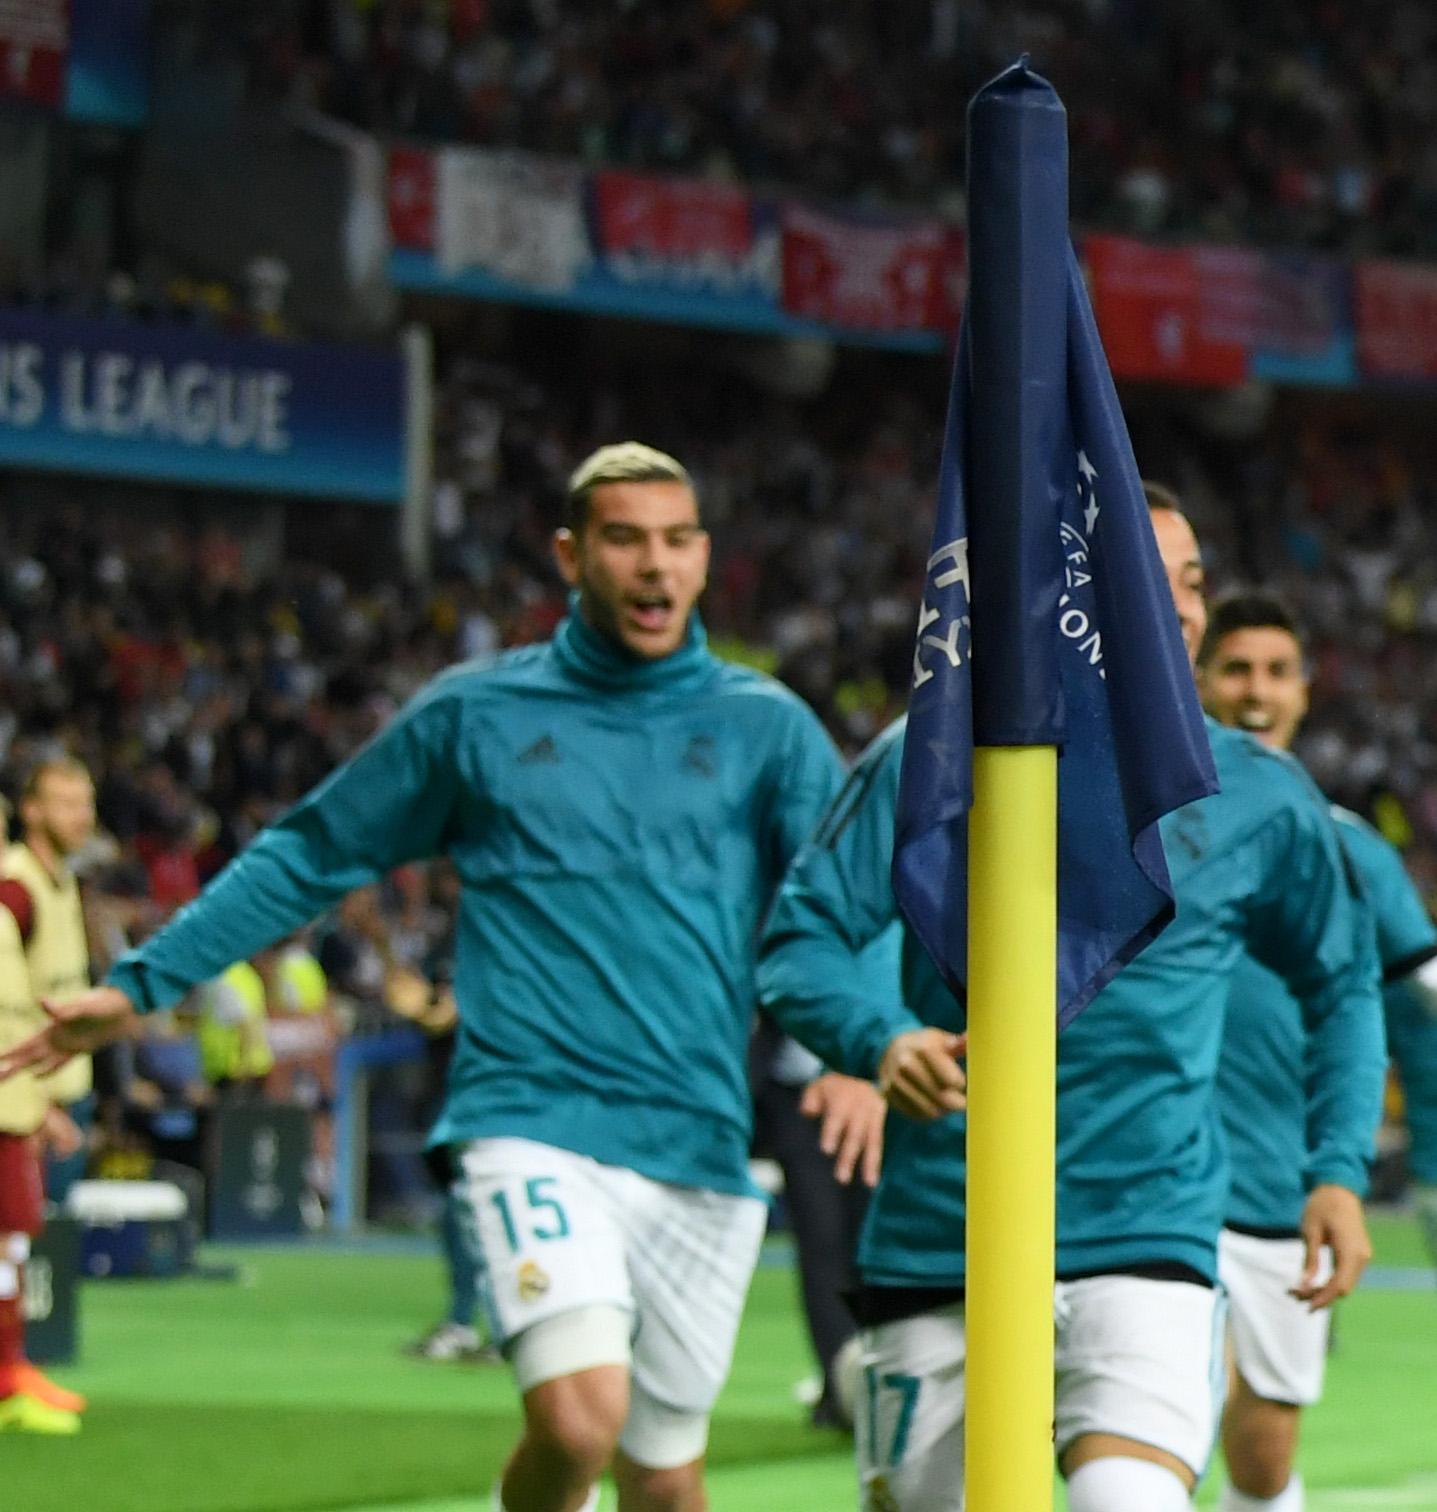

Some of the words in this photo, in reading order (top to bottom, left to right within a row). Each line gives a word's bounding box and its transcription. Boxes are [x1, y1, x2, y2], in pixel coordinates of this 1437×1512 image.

[60, 348, 294, 454] LEAGUE
[491, 1177, 569, 1254] 15
[866, 1366, 921, 1468] 17
